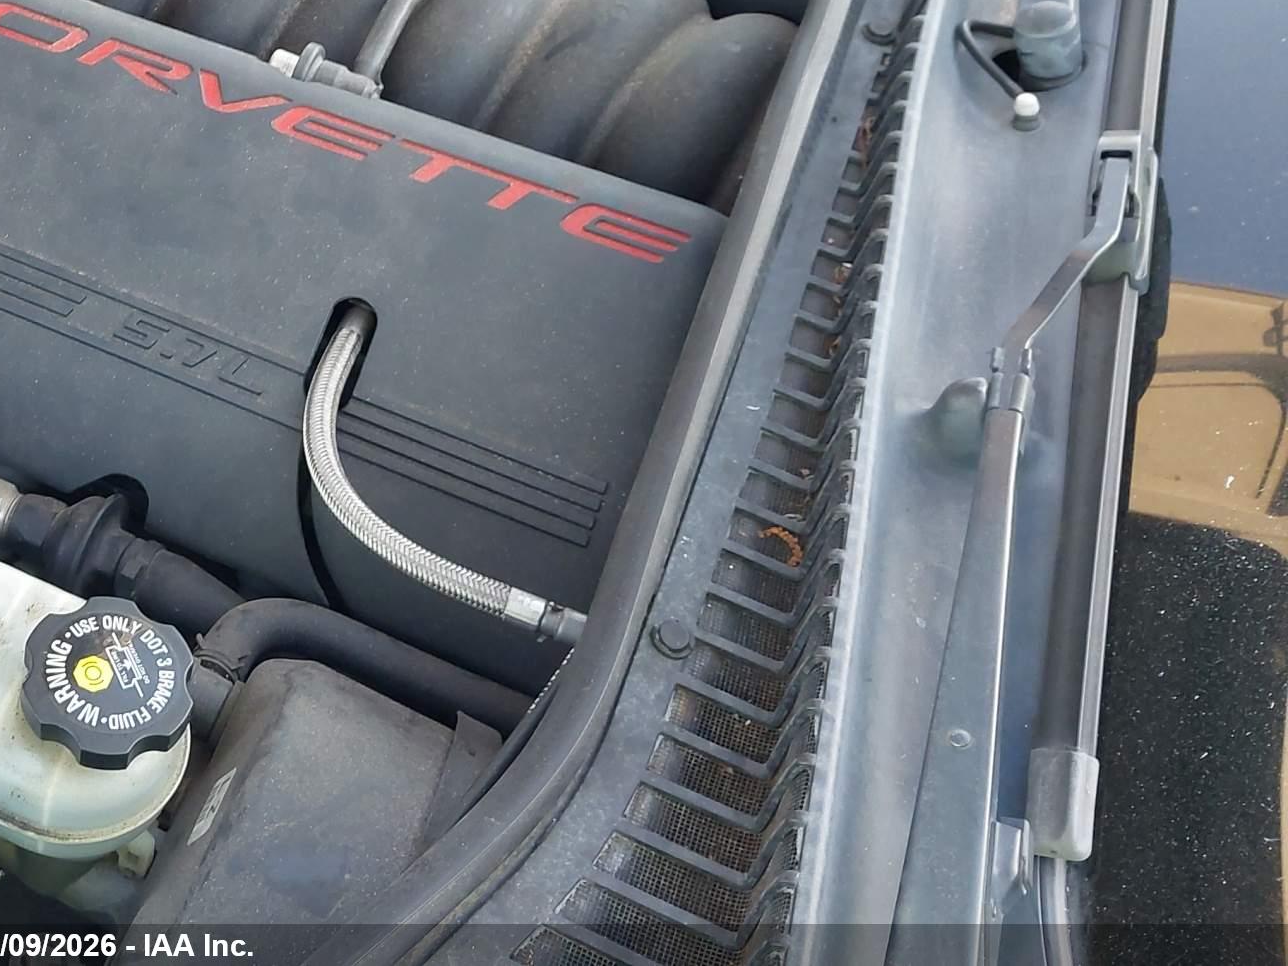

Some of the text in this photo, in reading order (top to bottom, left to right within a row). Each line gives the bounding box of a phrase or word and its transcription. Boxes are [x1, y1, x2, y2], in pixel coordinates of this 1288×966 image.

[112, 317, 263, 397] 5.7L
[45, 614, 175, 730] WARNING USE ONLY DOT 3 BRAKE FLUID
